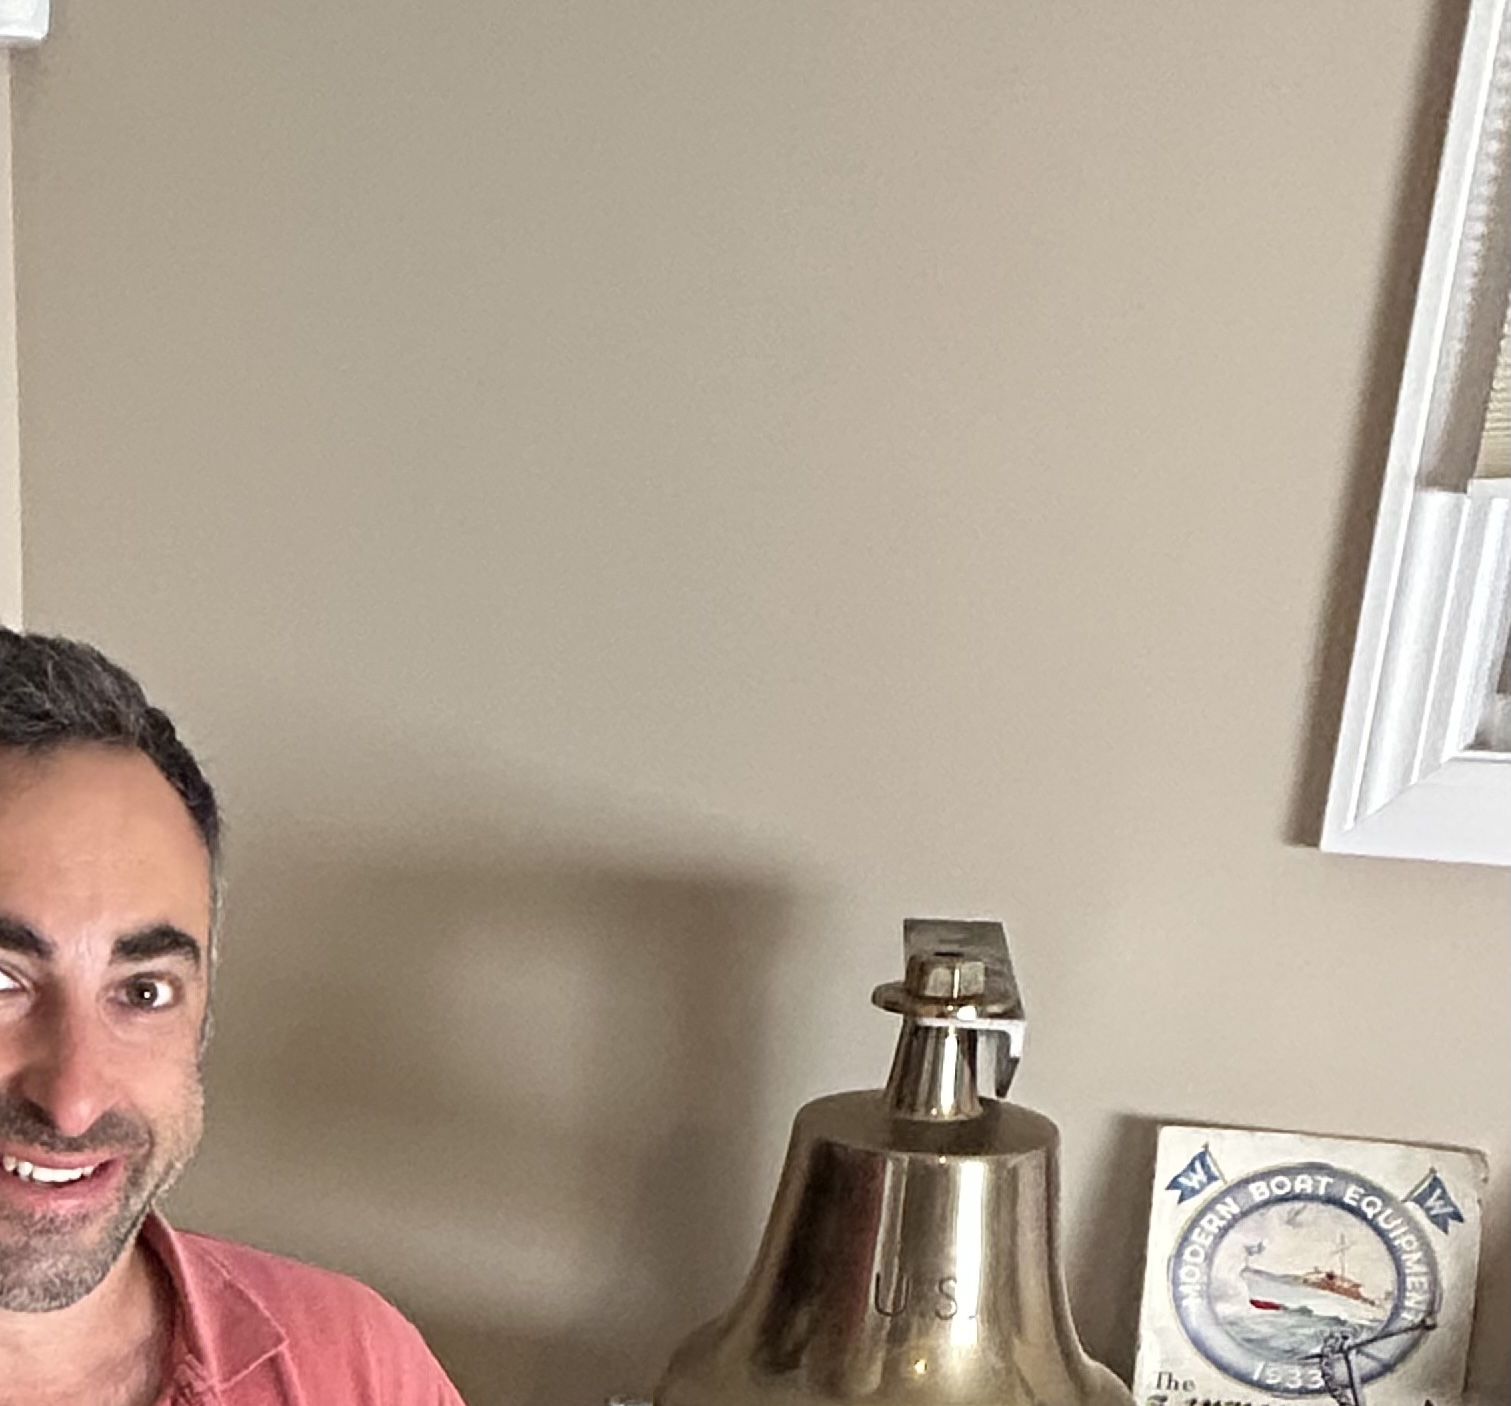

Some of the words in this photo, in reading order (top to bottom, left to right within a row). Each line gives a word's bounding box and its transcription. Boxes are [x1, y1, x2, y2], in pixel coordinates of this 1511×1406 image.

[1177, 1160, 1209, 1191] W
[1248, 1174, 1338, 1201] BOAT
[1423, 1186, 1448, 1217] W
[1177, 1196, 1241, 1307] MODERN
[1342, 1183, 1431, 1322] EQUIPMENT
[1156, 1370, 1197, 1392] The
